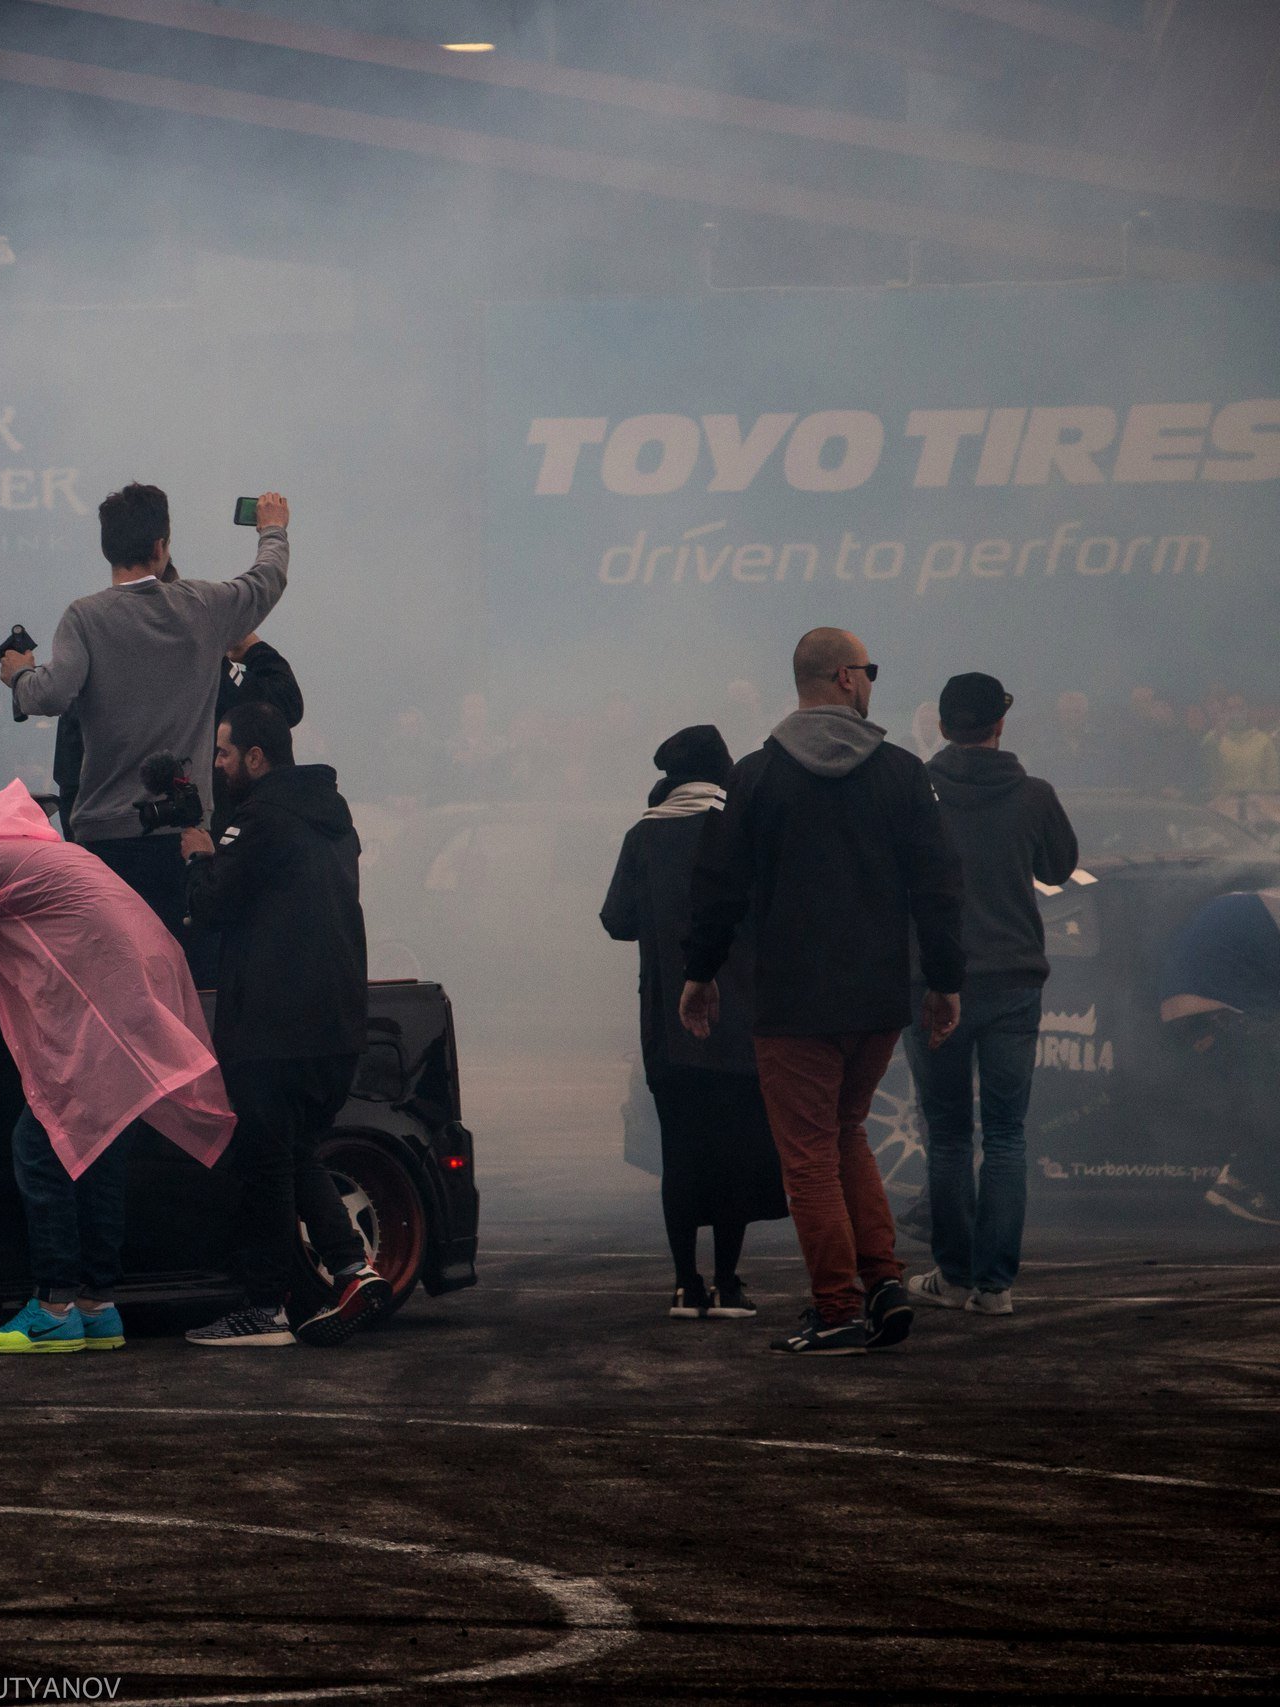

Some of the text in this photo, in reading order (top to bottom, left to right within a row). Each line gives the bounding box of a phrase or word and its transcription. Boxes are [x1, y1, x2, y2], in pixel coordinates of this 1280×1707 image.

[527, 398, 1280, 496] TOYO TIRES
[836, 531, 906, 581] to
[915, 521, 1212, 597] perform
